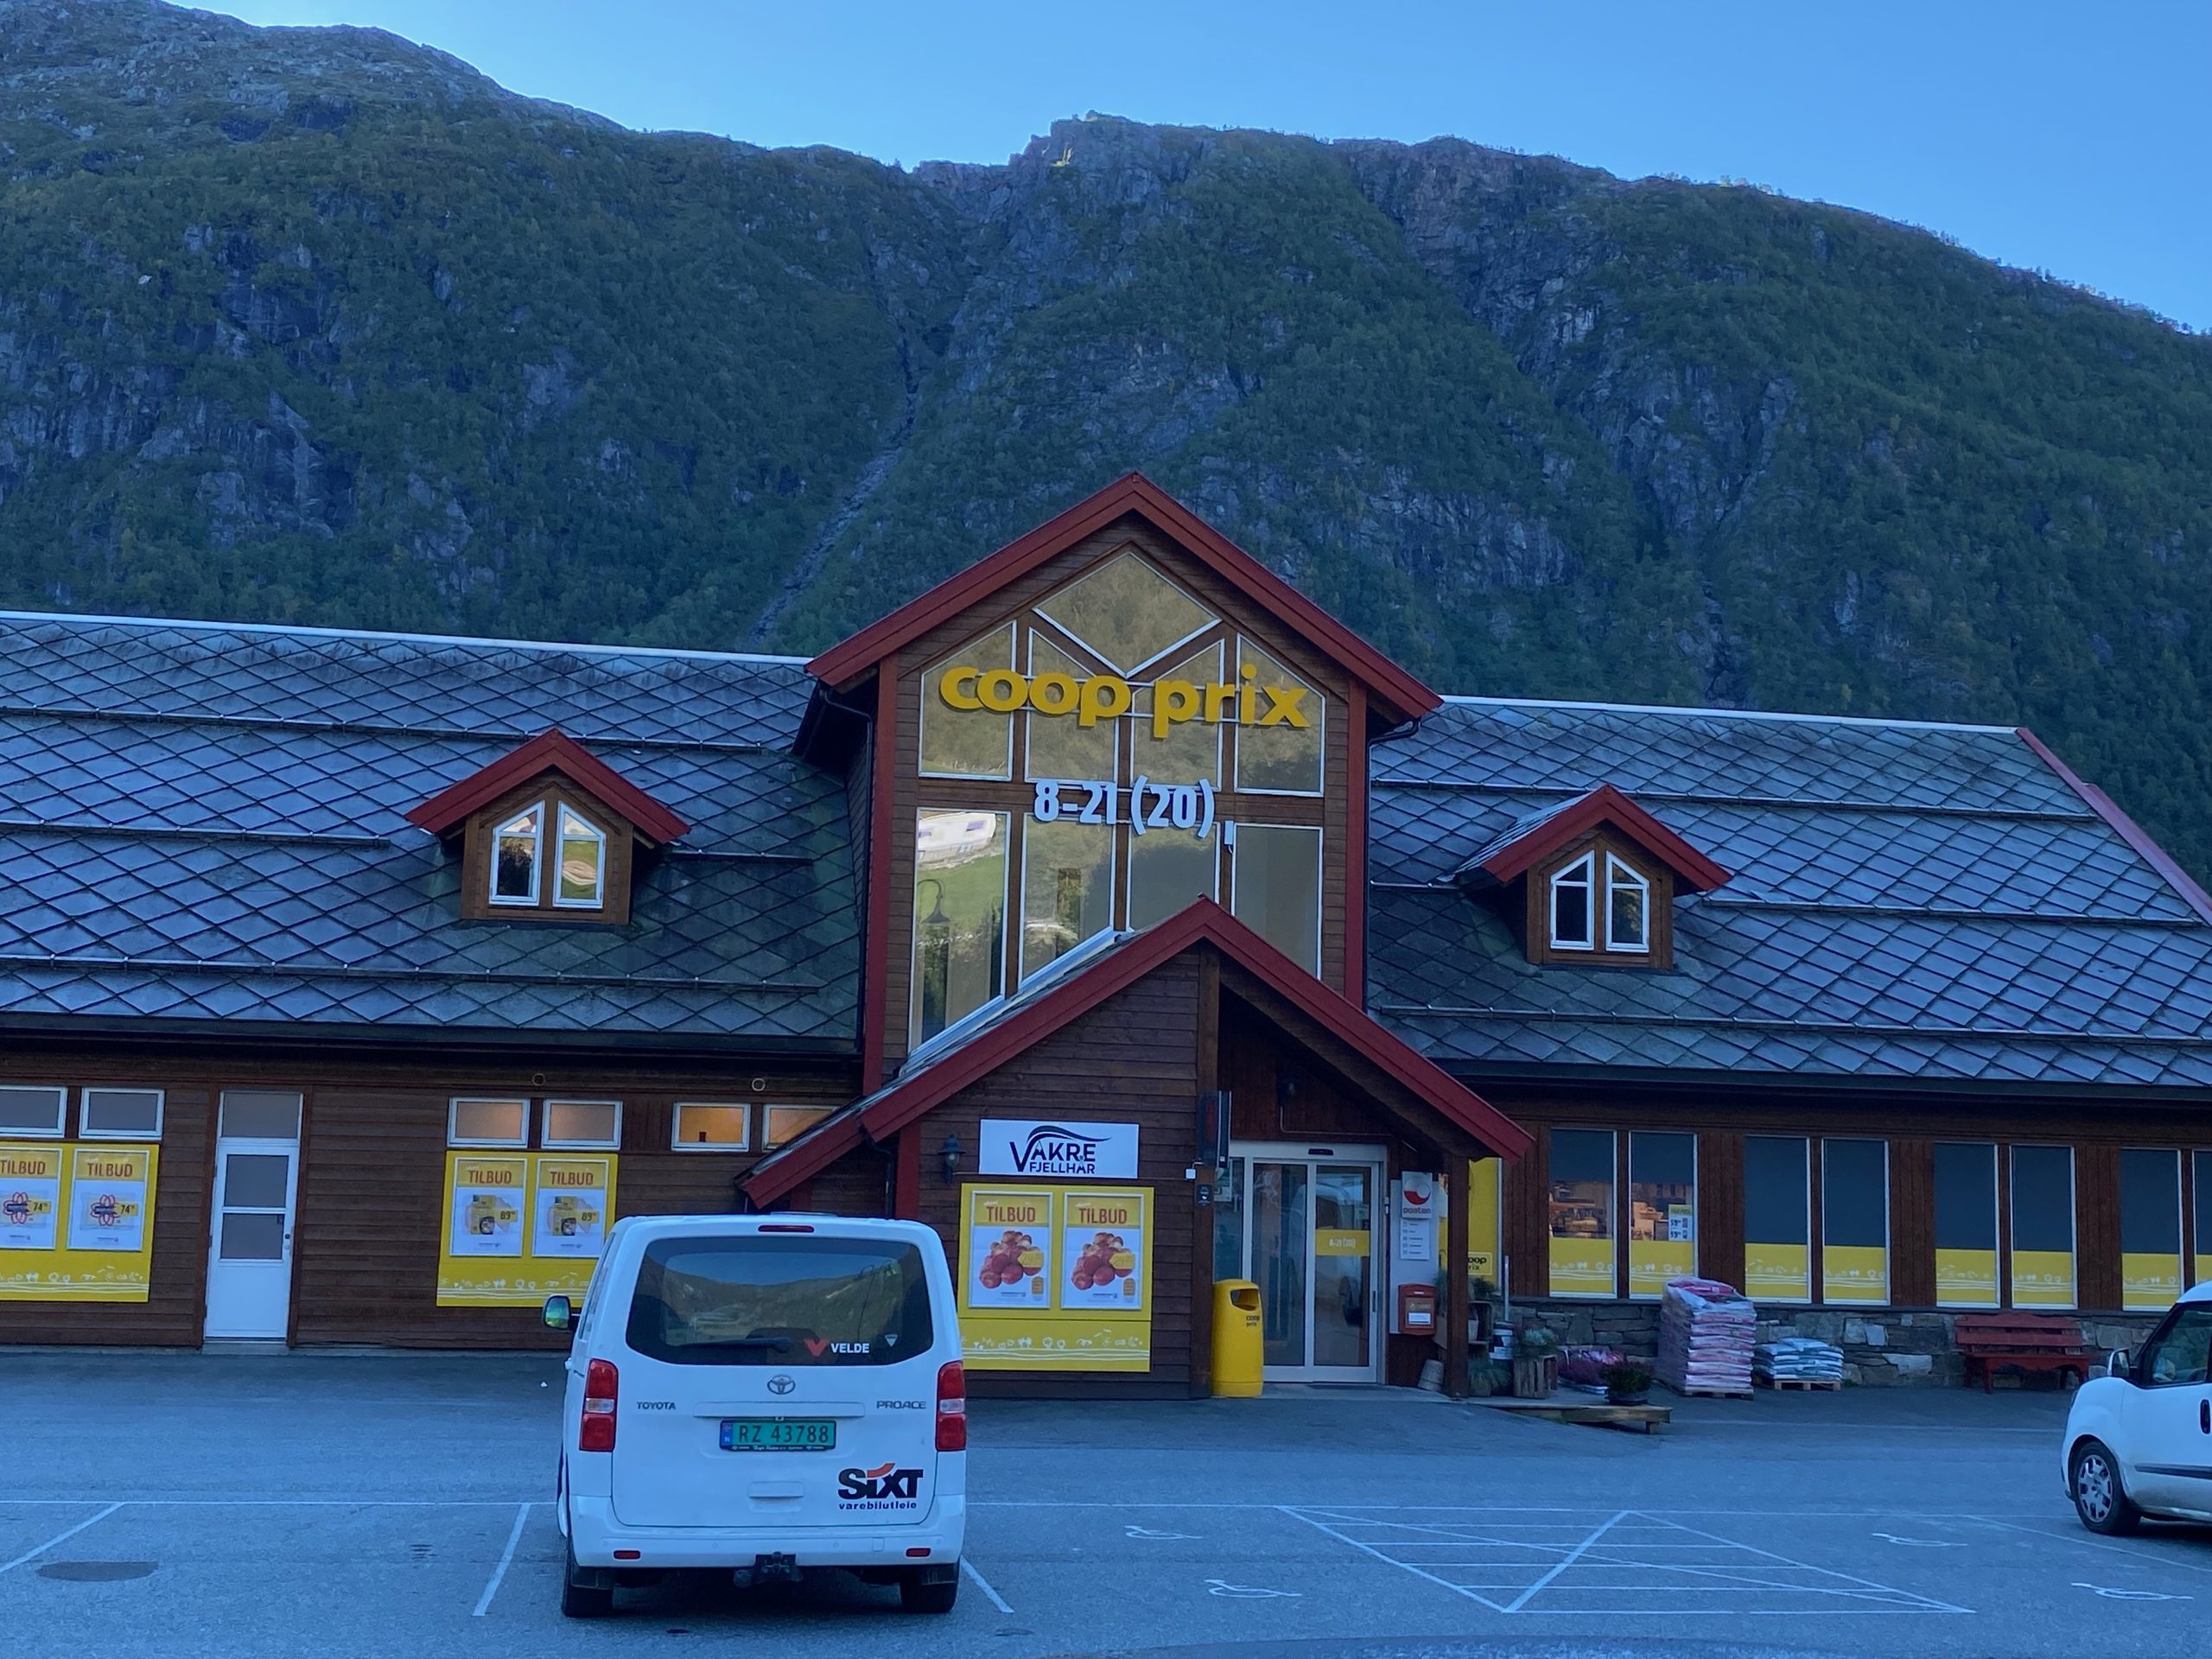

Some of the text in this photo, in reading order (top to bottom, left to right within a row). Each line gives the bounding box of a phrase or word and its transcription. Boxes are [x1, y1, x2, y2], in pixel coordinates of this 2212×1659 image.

[940, 664, 1311, 738] coop prix
[1034, 775, 1215, 839] 8-21 (20)
[1009, 1135, 1096, 1172] VAKRE
[1, 1160, 46, 1175] TILBUD
[88, 1162, 133, 1177] TILBUD
[468, 1170, 512, 1184] TILBUD
[550, 1171, 594, 1185] TILBUD
[987, 1205, 1036, 1222] TILBUD
[1078, 1208, 1127, 1224] TILBUD
[830, 1343, 869, 1353] VELDE
[637, 1402, 677, 1410] TOYOTA
[877, 1401, 926, 1409] PROACE
[739, 1425, 829, 1443] RZ 43788
[839, 1501, 917, 1510] varebilutleie
